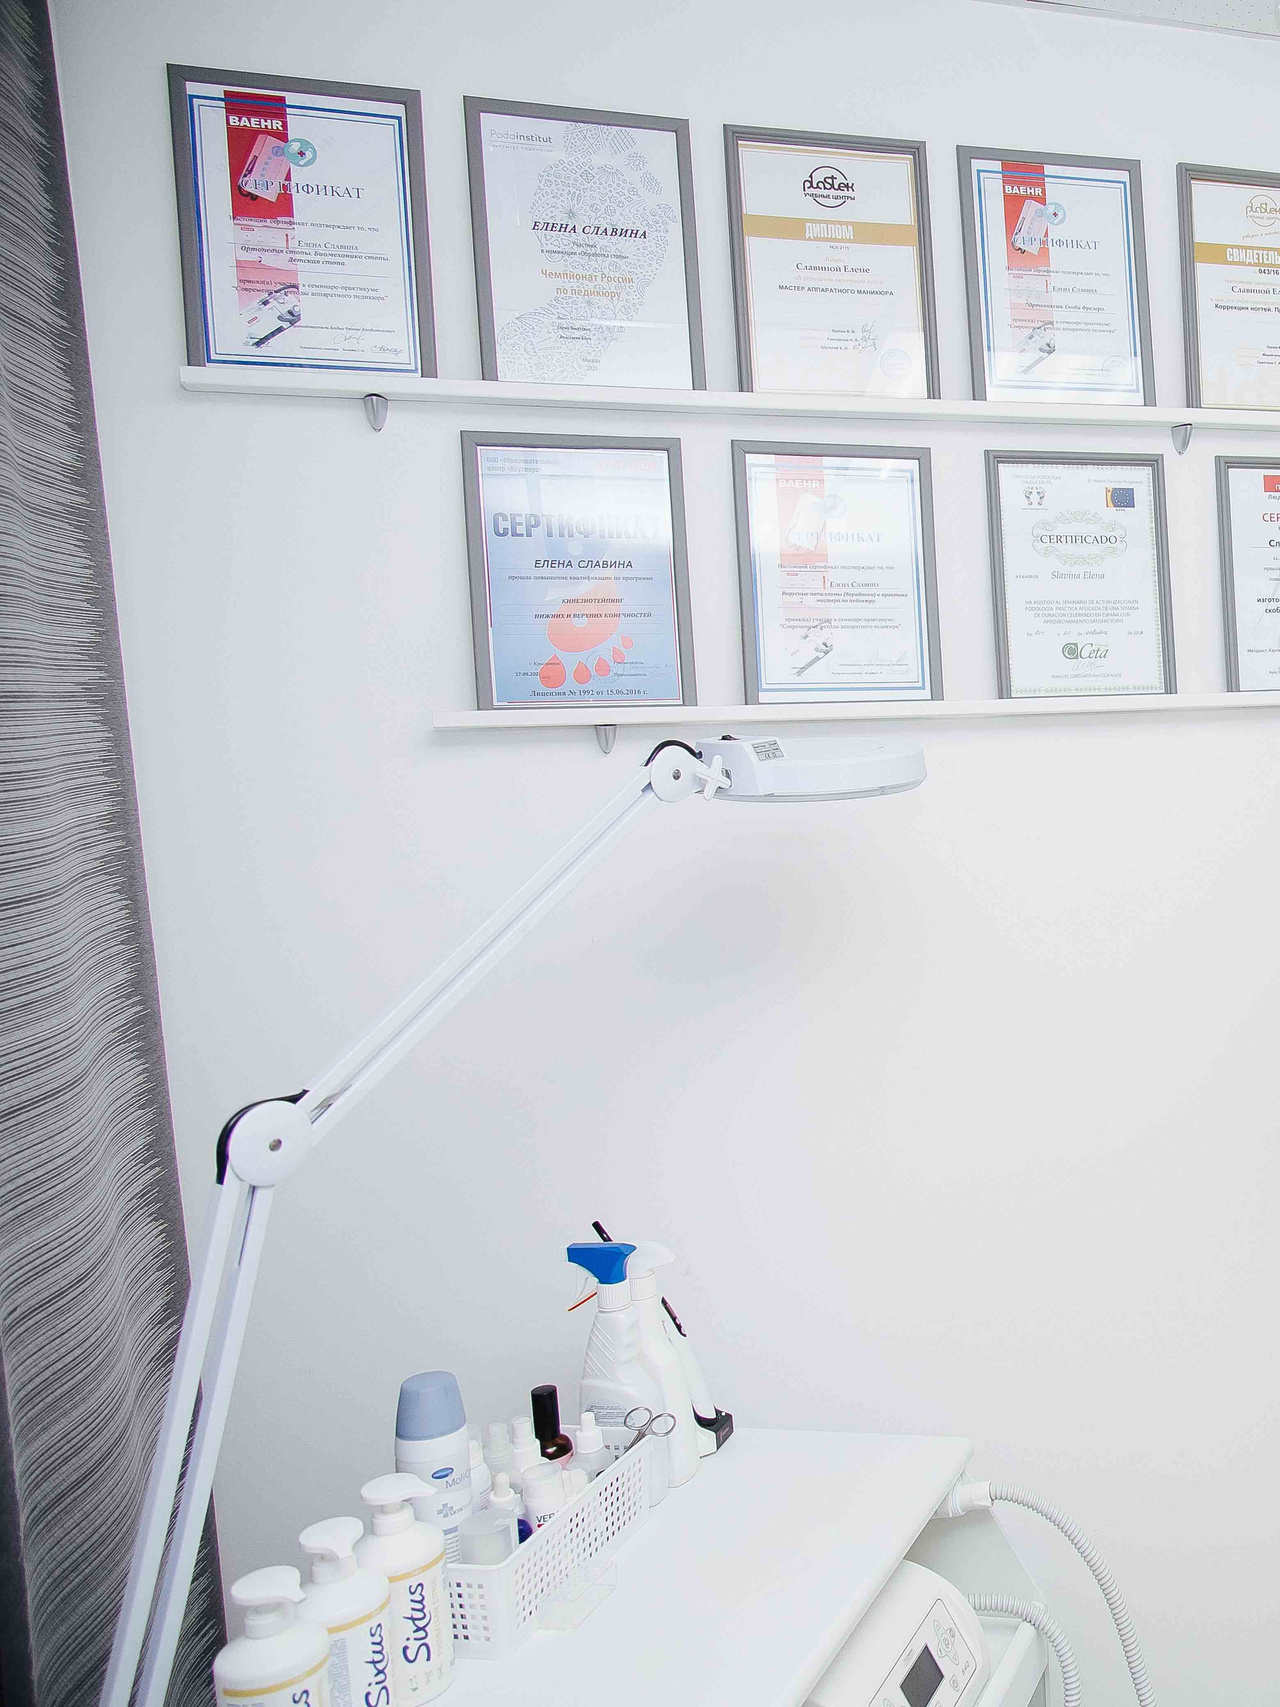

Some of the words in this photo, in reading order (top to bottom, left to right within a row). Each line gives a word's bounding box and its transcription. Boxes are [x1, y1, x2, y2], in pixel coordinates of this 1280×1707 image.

[229, 116, 284, 131] BAEHR
[490, 129, 552, 143] Podoinstitut
[239, 178, 365, 200] СЕРТИФИКАТ
[1005, 185, 1043, 197] BAEHR
[804, 192, 830, 200] УЧЕБНЫЕ
[532, 221, 578, 234] ЕЛЕНА
[582, 224, 648, 240] СЛАВИНА
[805, 222, 853, 240] ДИПЛОМ
[1012, 236, 1100, 250] СЕРТИФИКАТ
[796, 263, 841, 272] Славиной
[844, 265, 870, 274] Елене
[541, 269, 598, 282] Чемпионат
[601, 273, 633, 284] России
[556, 287, 568, 295] по
[571, 289, 621, 300] педикюру
[807, 287, 855, 295] АППАРАТНОГО
[1231, 286, 1270, 294] Славиной
[1215, 303, 1249, 311] Коррекция
[778, 479, 820, 489] BAEHR
[1039, 534, 1118, 545] CERTIFICADO
[534, 560, 573, 569] ЕЛЕНА
[577, 560, 633, 570] СЛАВИНА
[1051, 571, 1081, 579] Slavina
[1083, 571, 1105, 579] Elena
[604, 611, 652, 619] КОНЕЧНОСТЕЙ
[1080, 643, 1109, 659] Ceta
[402, 1582, 432, 1663] Sixtus
[365, 1622, 390, 1707] Sixtus
